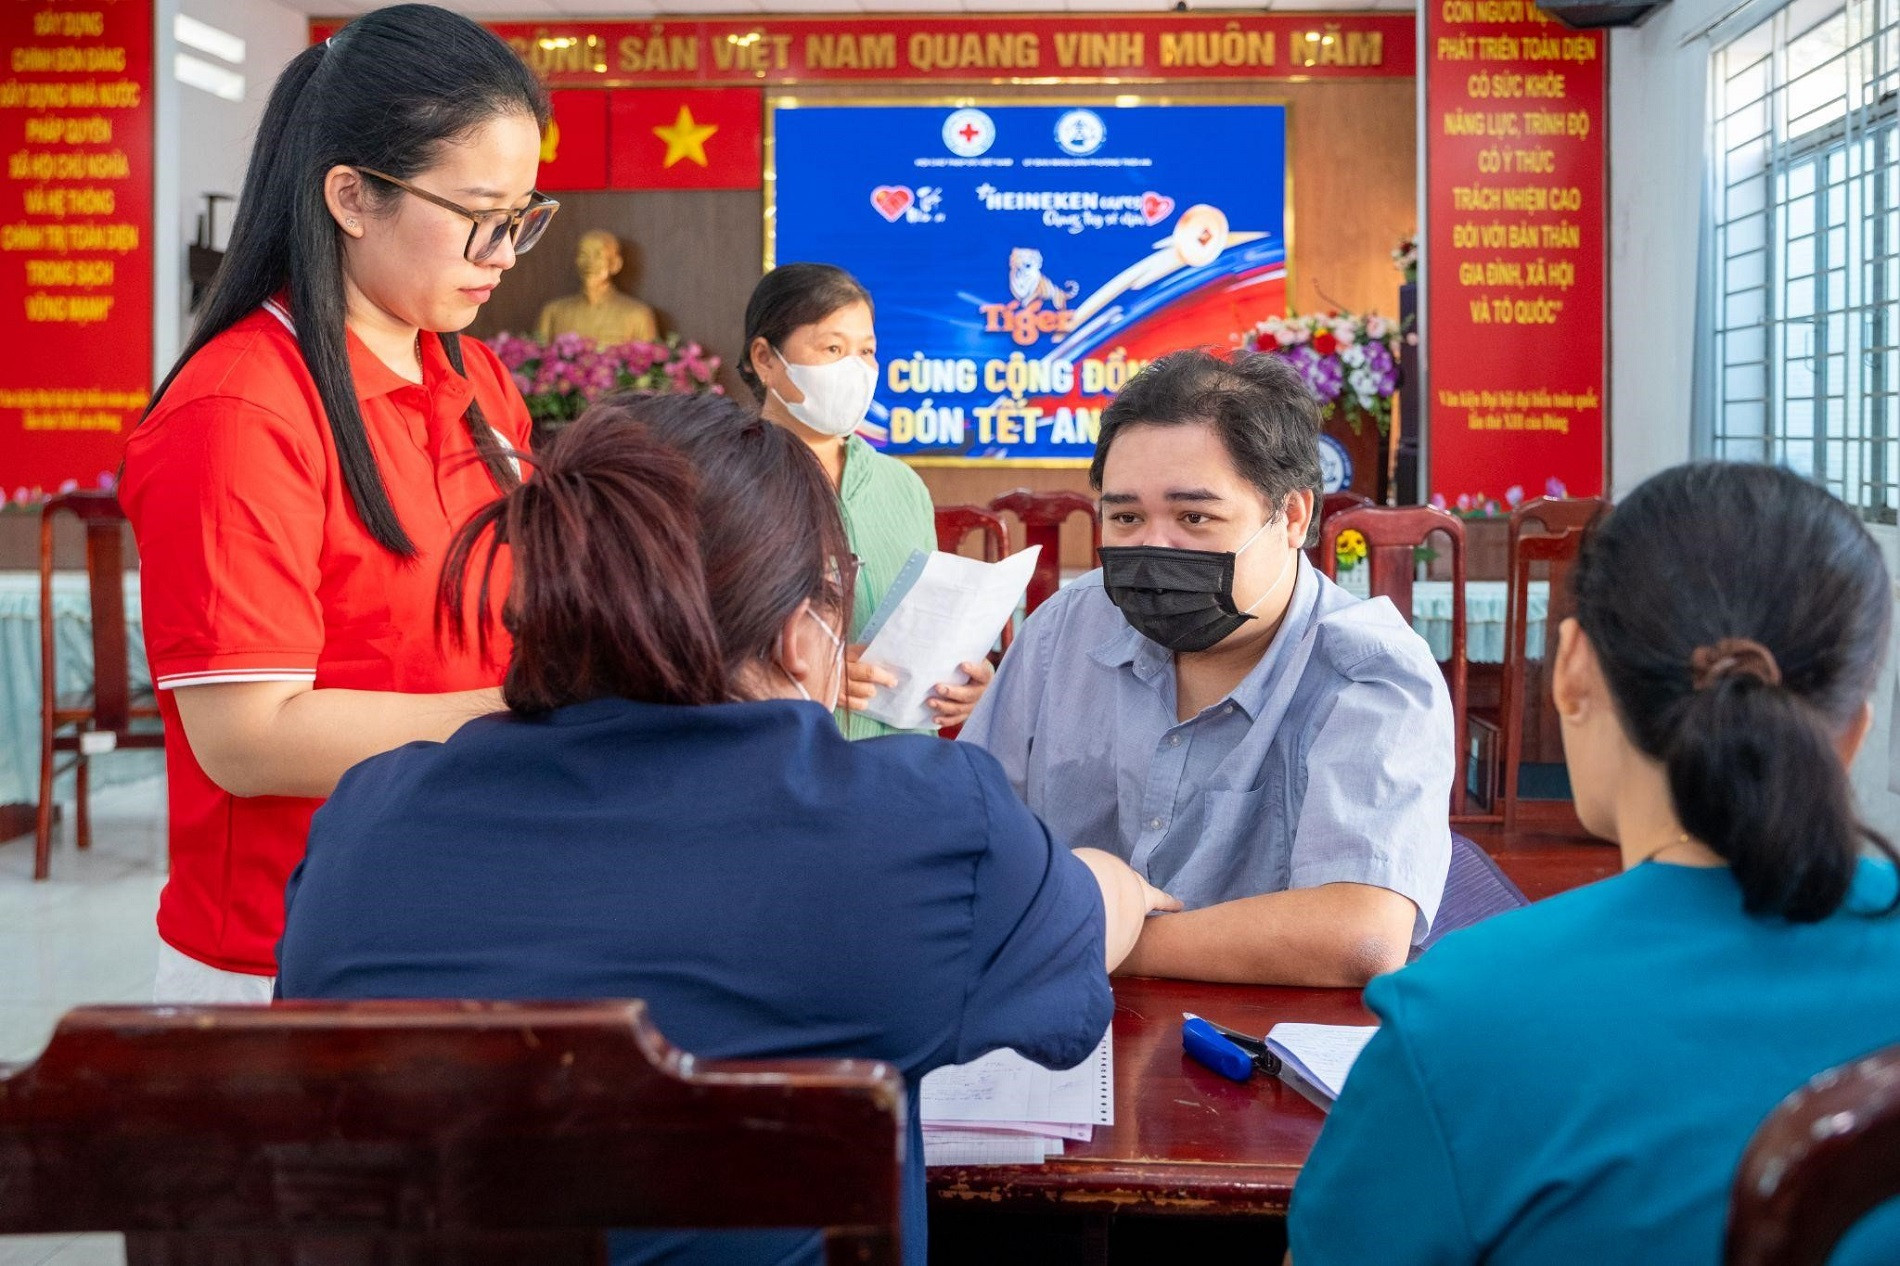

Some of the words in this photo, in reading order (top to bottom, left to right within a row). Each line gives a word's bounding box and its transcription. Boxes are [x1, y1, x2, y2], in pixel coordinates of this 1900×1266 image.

[617, 24, 697, 70] SẢN
[711, 28, 793, 77] VIỆT
[807, 34, 897, 69] NAM
[908, 32, 1039, 71] QUANG
[1054, 31, 1145, 67] VINH
[1158, 22, 1276, 66] MUÔN
[986, 191, 1098, 210] HEINEKEN
[1549, 187, 1582, 211] CAO
[1459, 262, 1485, 286] GIA
[979, 300, 1076, 346] Tiger
[888, 351, 977, 393] CÙNG
[984, 351, 1074, 400] CỘNG
[889, 398, 964, 444] ĐÓN
[972, 397, 1043, 444] TẾT
